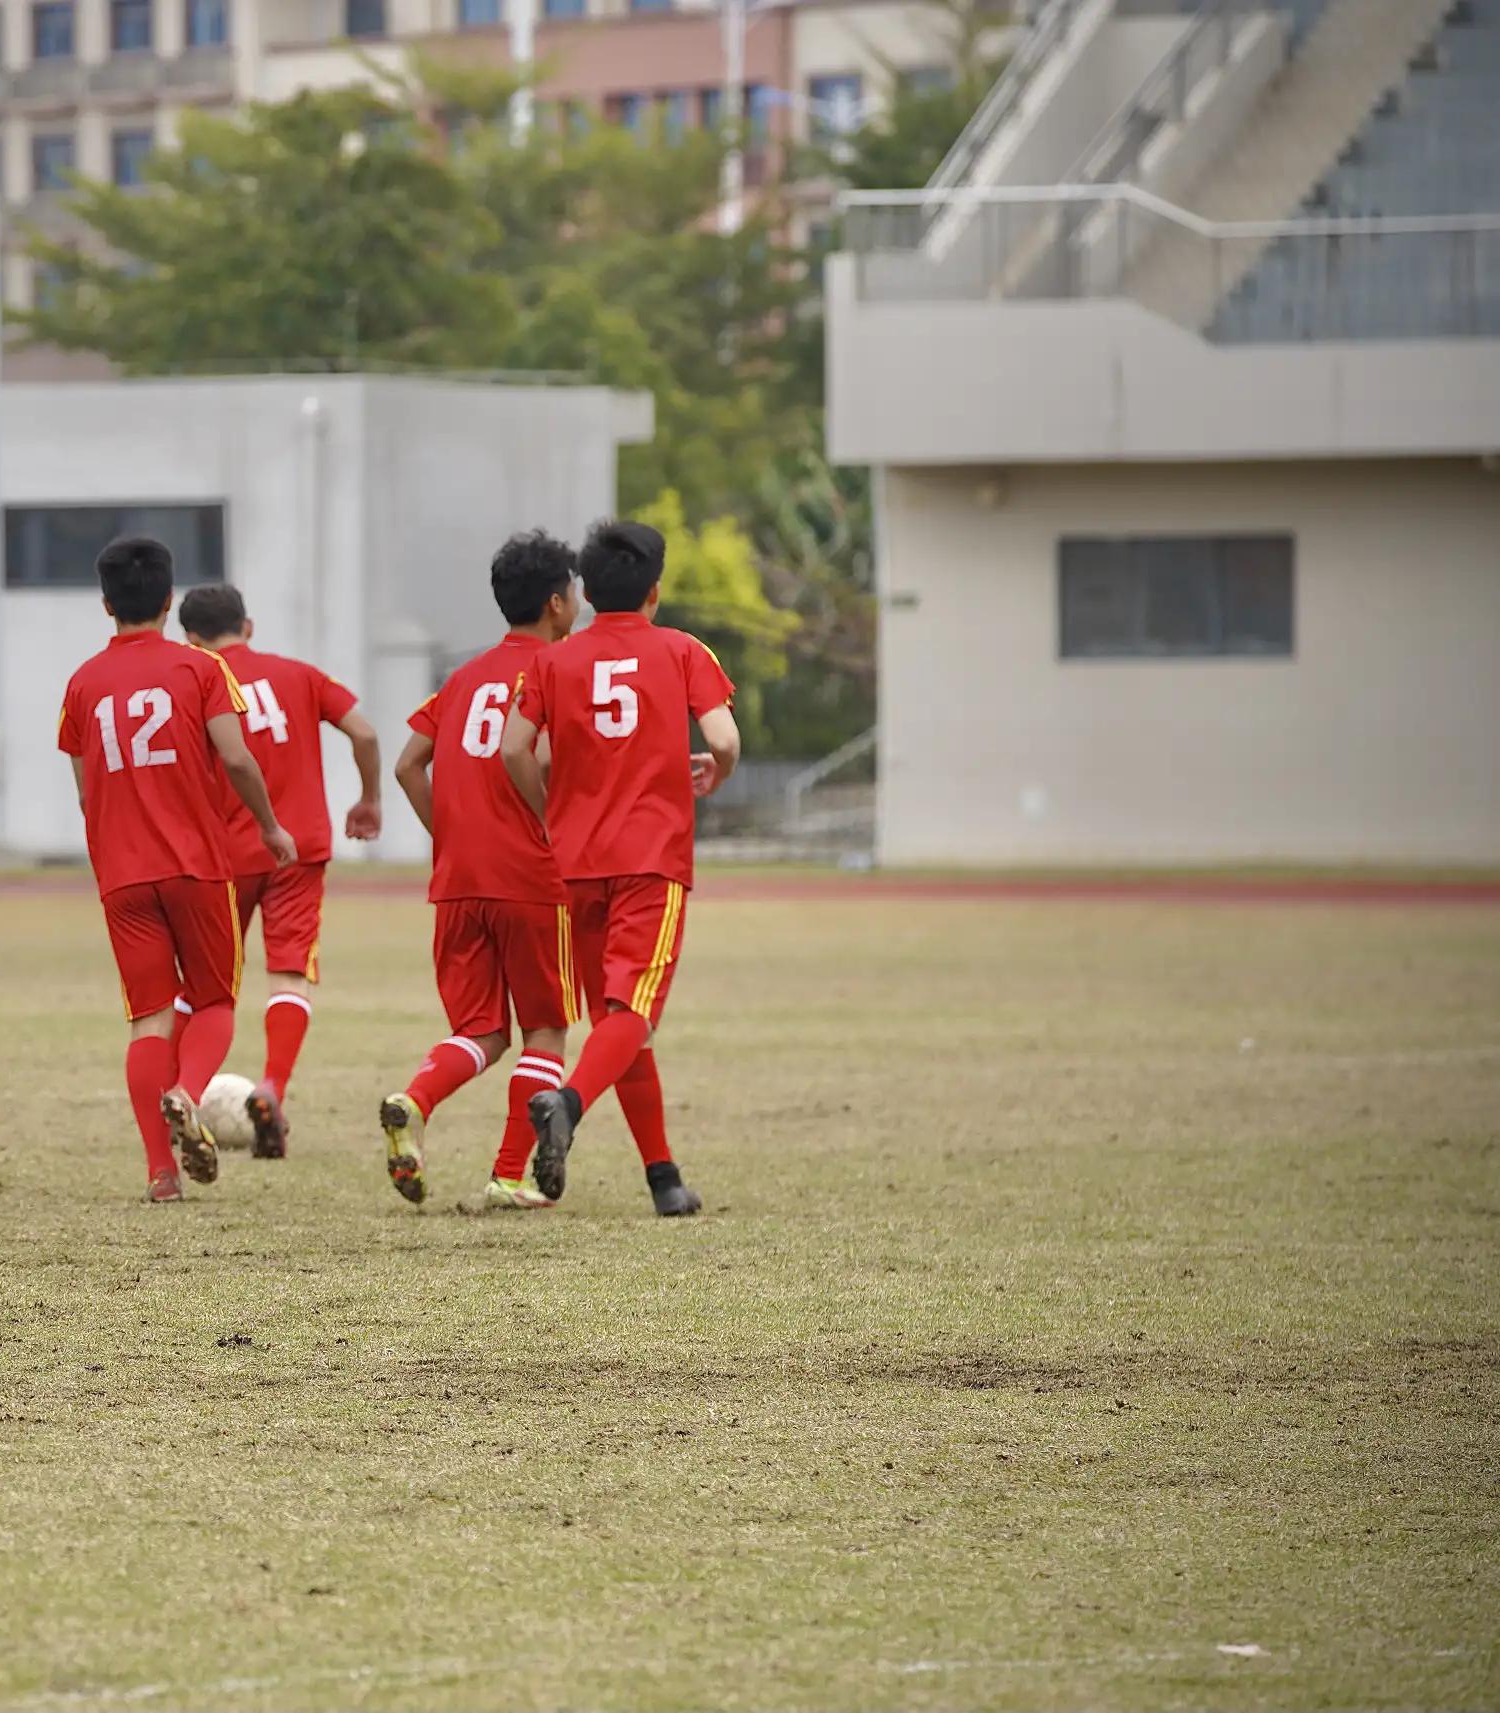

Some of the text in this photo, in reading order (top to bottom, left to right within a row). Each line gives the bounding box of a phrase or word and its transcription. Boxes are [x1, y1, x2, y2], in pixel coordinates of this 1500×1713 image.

[94, 687, 177, 773] 12
[240, 678, 288, 744] 4
[461, 682, 509, 758] 6
[592, 657, 639, 738] 5
